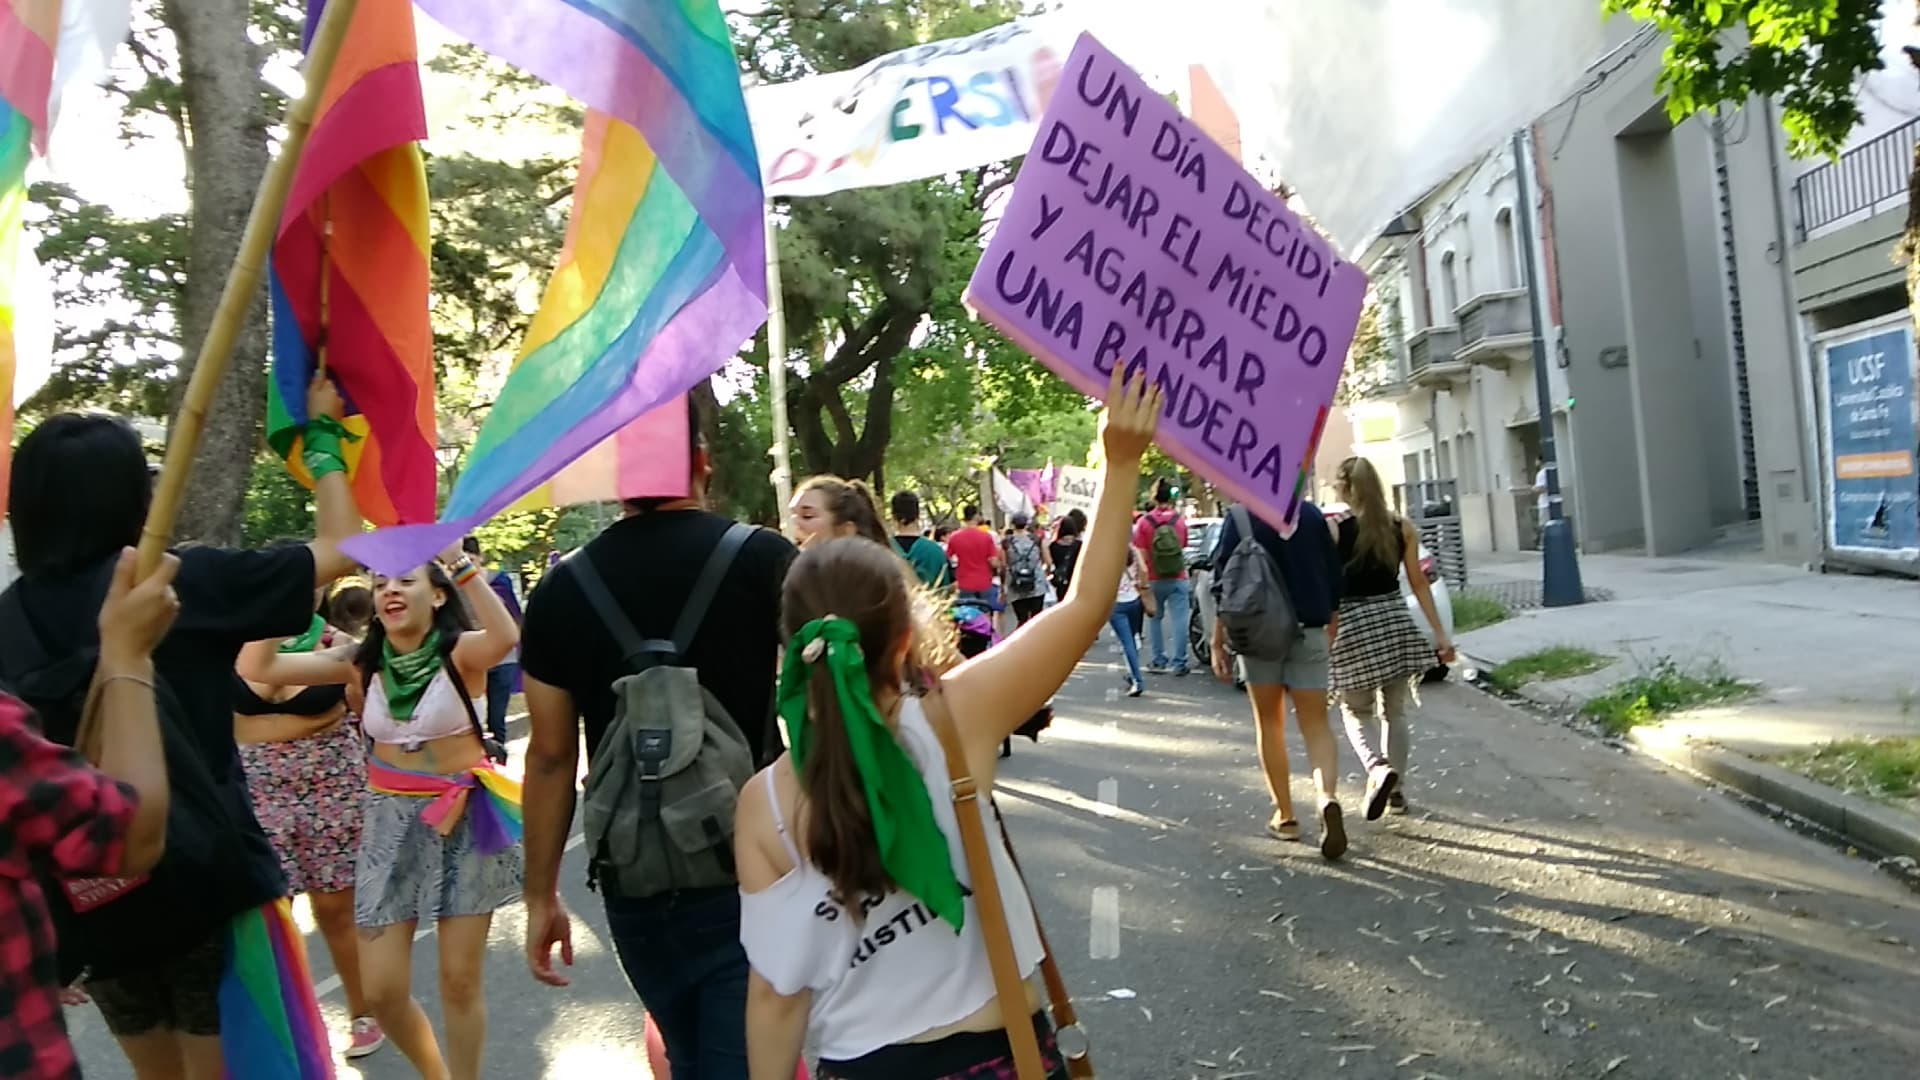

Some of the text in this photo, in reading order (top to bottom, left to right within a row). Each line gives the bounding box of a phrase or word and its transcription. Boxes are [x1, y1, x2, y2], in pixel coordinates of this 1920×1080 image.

[1077, 54, 1141, 137] UN
[1042, 120, 1160, 237] DEJAR
[1161, 215, 1202, 277] EL
[995, 250, 1281, 494] UNA BANDERA
[1030, 194, 1266, 405] Y AGARRAR
[1848, 352, 1885, 385] UCSF
